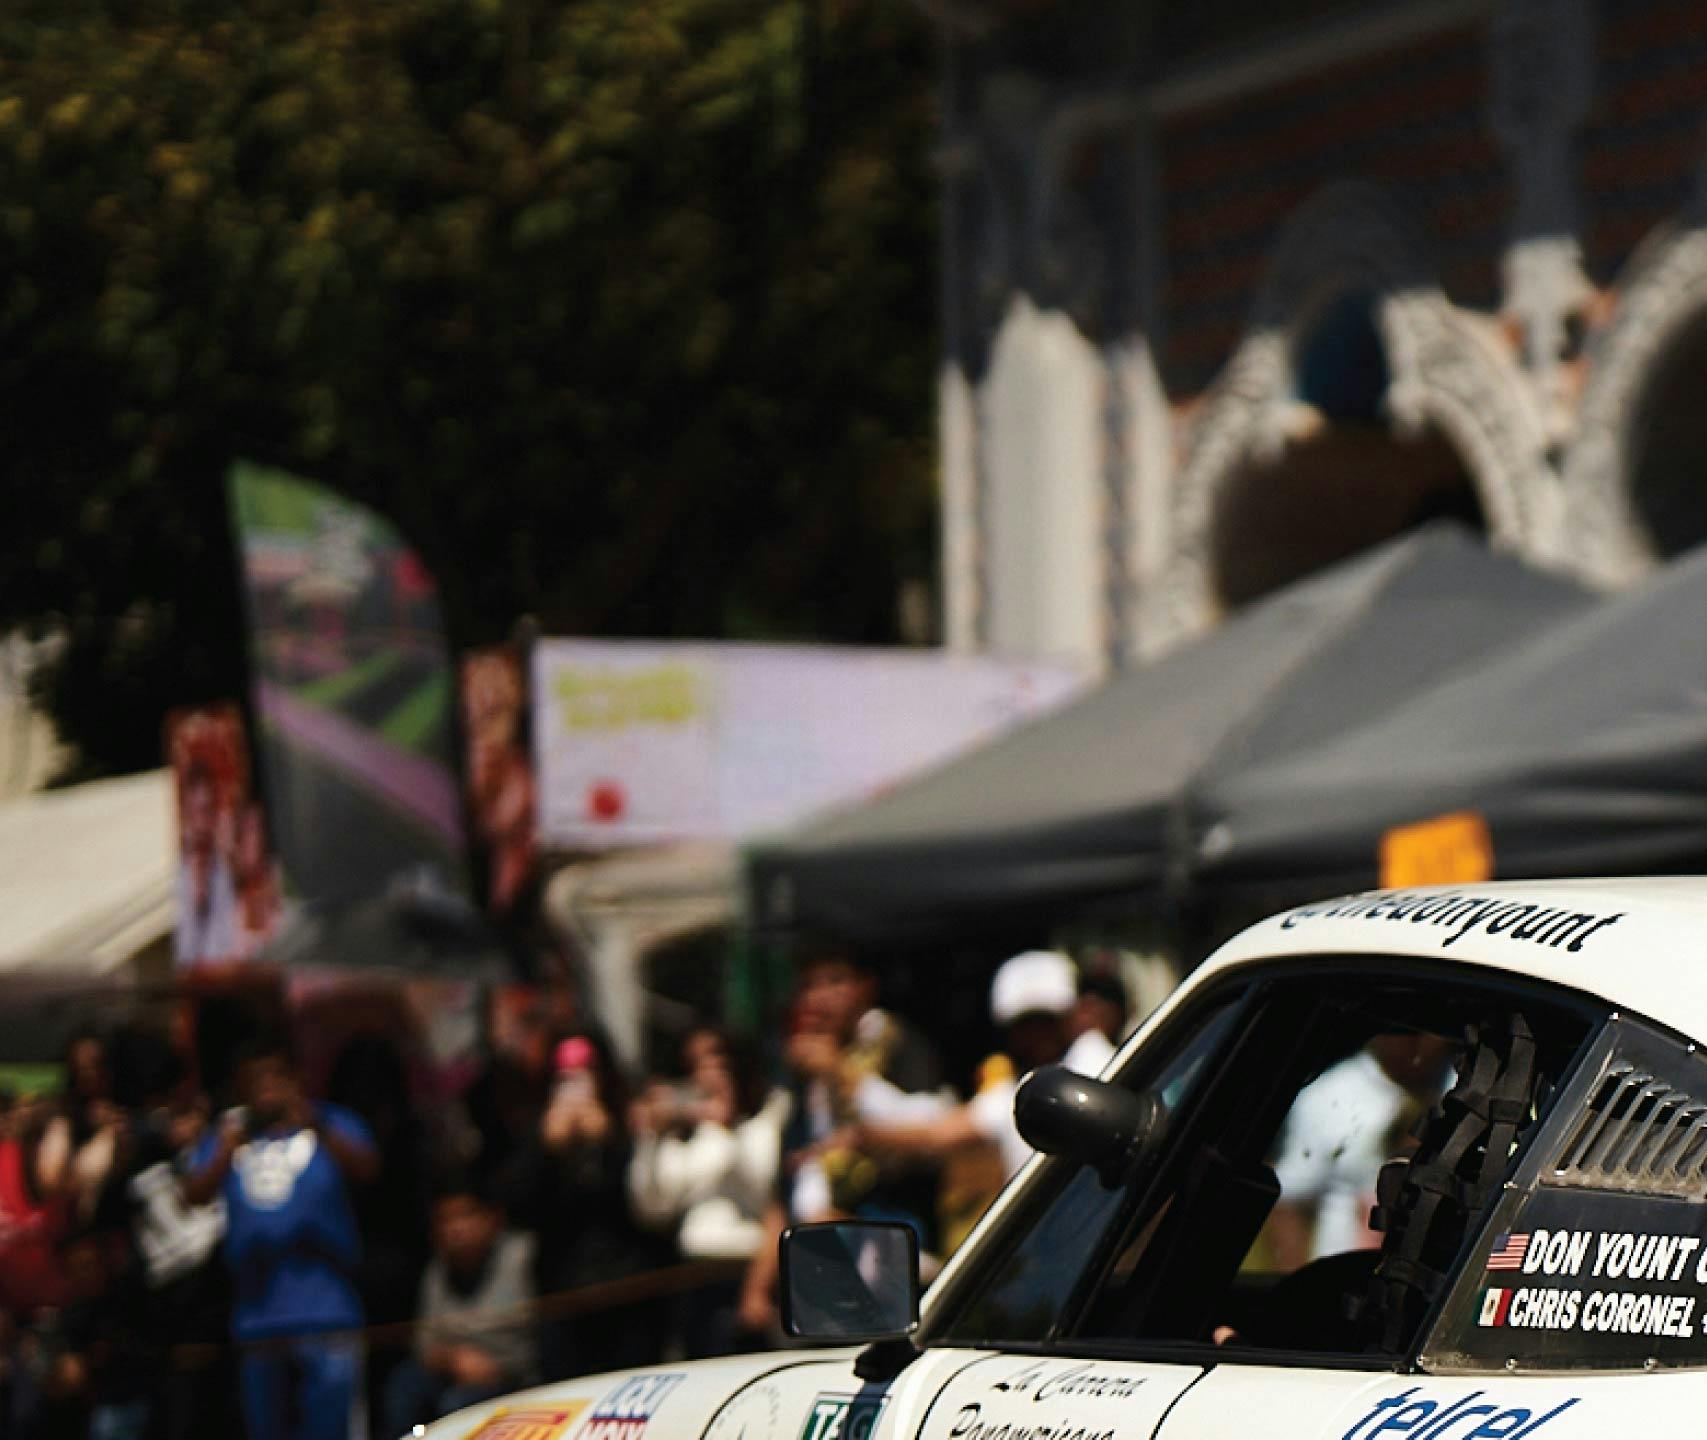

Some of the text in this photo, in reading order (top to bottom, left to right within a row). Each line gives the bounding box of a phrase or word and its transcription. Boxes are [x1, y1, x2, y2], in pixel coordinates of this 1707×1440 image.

[1523, 1230, 1592, 1276] DON
[1592, 1233, 1700, 1282] YOUNT
[1509, 1286, 1582, 1332] CHRIS
[1582, 1289, 1698, 1338] CORONEL
